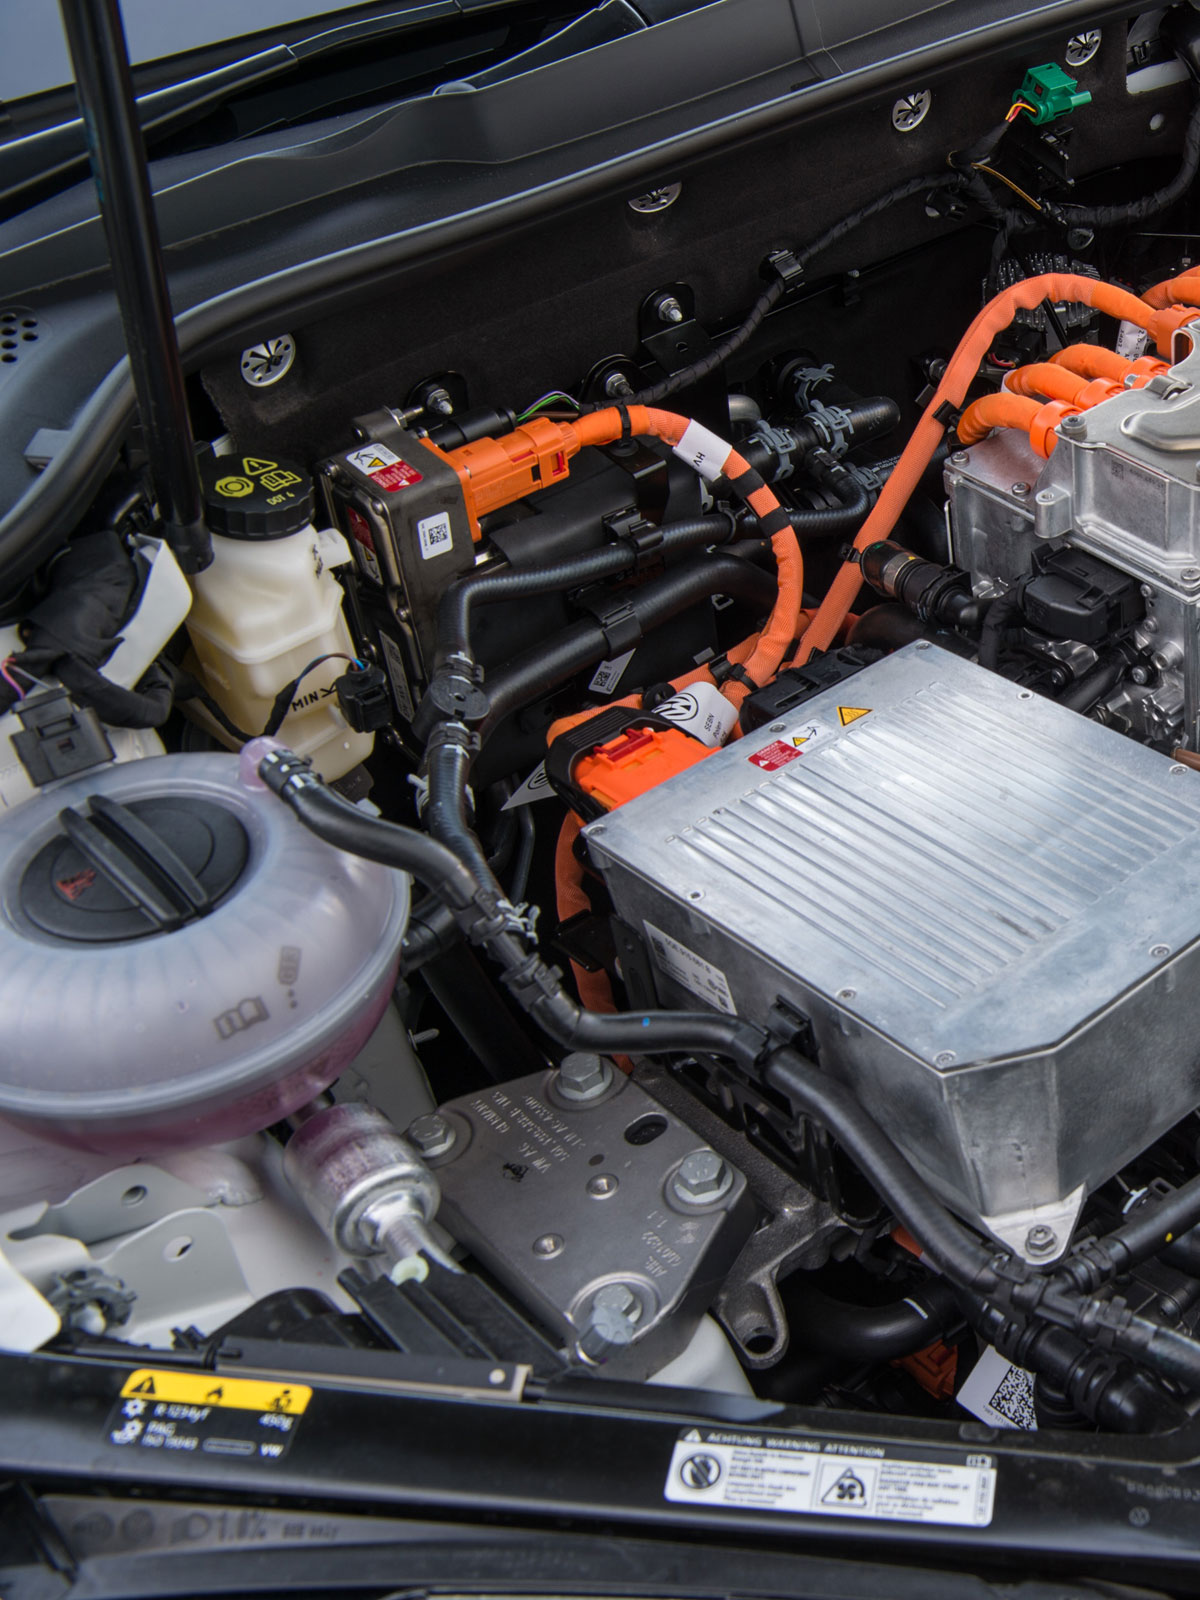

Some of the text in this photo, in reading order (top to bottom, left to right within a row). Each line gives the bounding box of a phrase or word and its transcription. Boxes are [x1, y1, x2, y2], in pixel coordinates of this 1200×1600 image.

[266, 494, 286, 506] DOT
[291, 691, 319, 711] MIN
[518, 1142, 552, 1174] VW AG
[259, 1443, 284, 1457] VW
[706, 1432, 886, 1458] ACHTUNG WARNING ATTENTION
